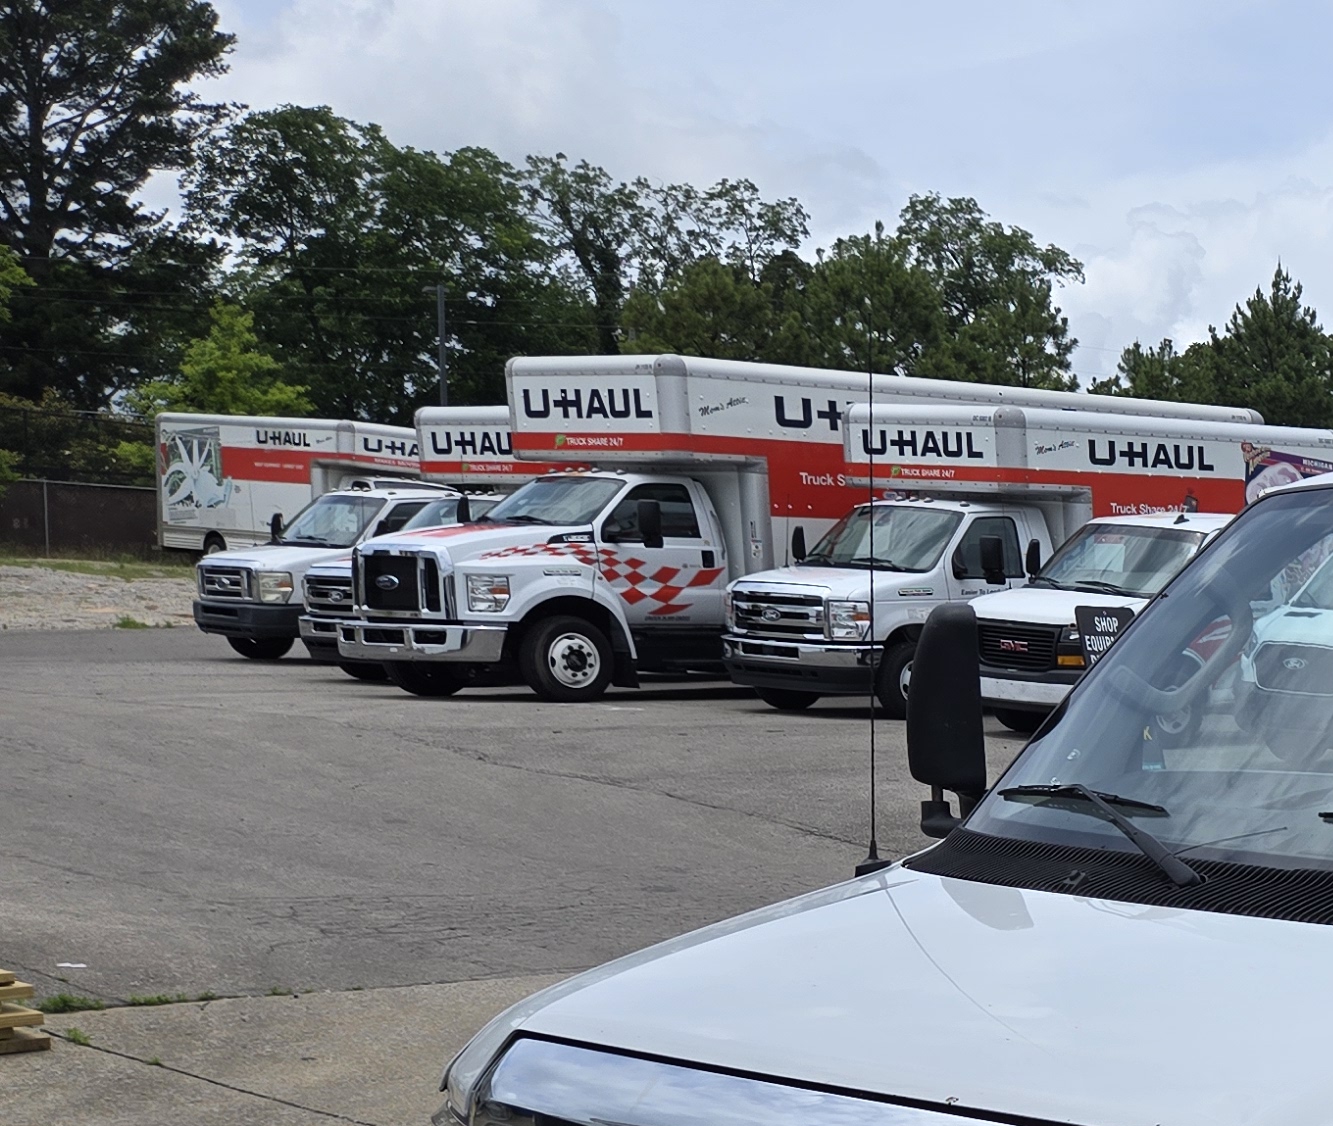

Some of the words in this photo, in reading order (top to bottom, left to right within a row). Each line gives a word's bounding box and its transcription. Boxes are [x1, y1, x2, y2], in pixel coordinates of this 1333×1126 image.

[430, 431, 513, 455] U-HAU
[566, 437, 587, 446] TRUCK
[587, 437, 608, 446] SHARE
[609, 437, 624, 446] 24/7
[1302, 458, 1333, 470] MICHIGAN
[800, 472, 833, 486] Truck
[901, 468, 921, 477] TRUCK
[921, 468, 940, 477] SHARE
[941, 469, 955, 478] 24/7
[1110, 502, 1137, 515] Truck
[1094, 616, 1118, 632] SHOP
[1000, 639, 1028, 652] GMC
[1084, 635, 1115, 652] EQUIP
